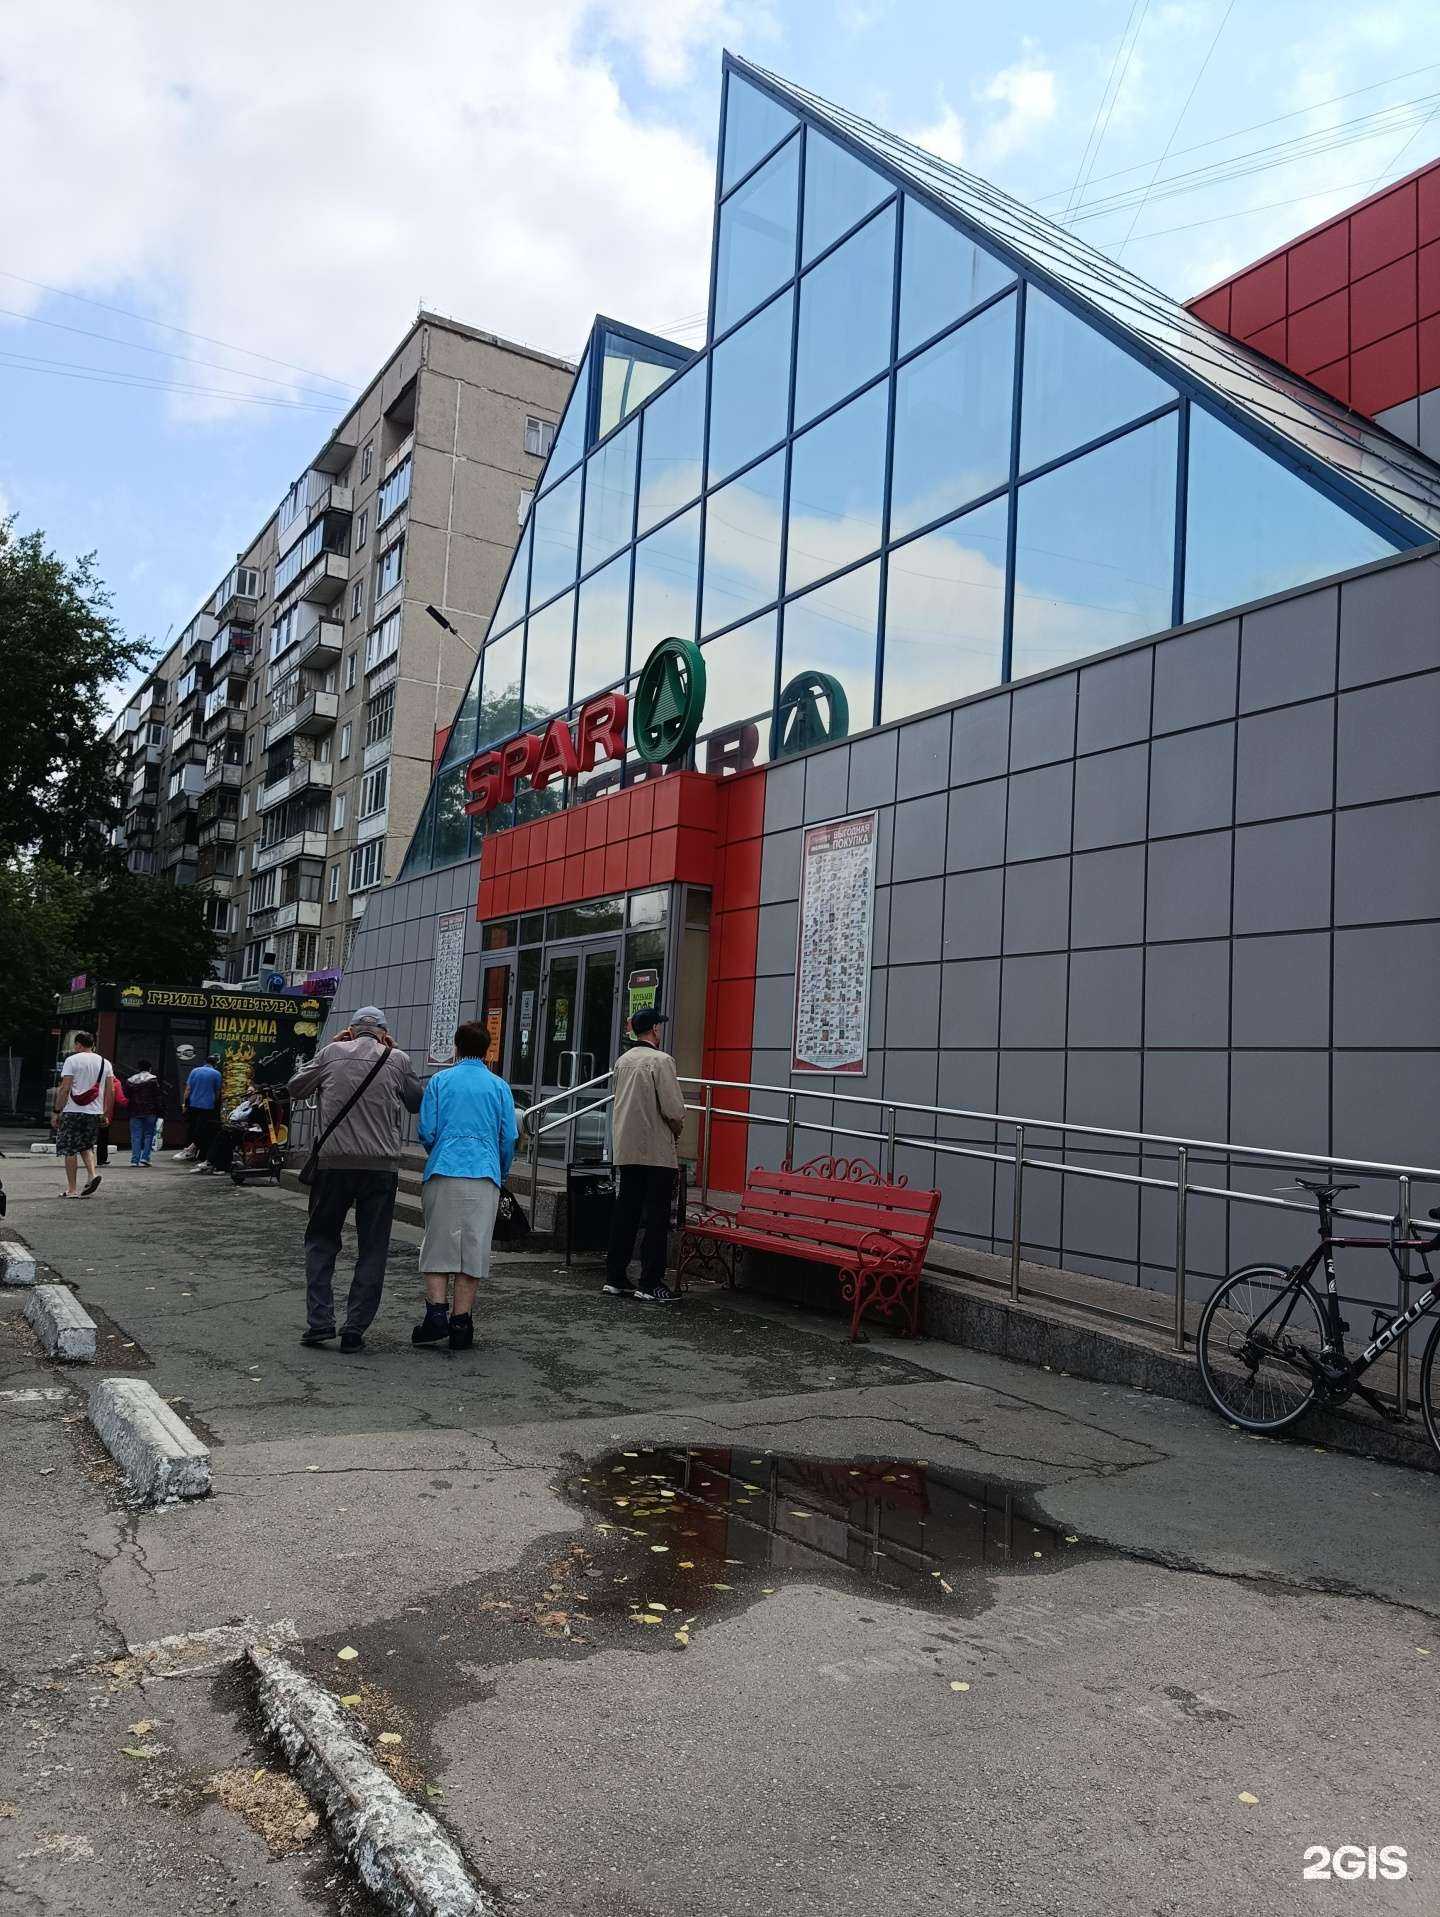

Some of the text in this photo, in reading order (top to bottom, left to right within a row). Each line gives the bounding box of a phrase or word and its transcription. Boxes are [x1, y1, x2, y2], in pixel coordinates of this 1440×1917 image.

[464, 692, 628, 815] SPAR
[833, 823, 870, 840] ВЫГОДНАЯ
[832, 833, 869, 850] ПОКУПКА
[147, 990, 208, 1008] ГРИЛЬ
[210, 995, 299, 1014] КУЛЬТУРА
[214, 1016, 277, 1035] ШАУРМА
[214, 1032, 240, 1041] СОЗДАЙ
[260, 1035, 277, 1043] ВКУС
[1363, 1290, 1436, 1362] FOCUS
